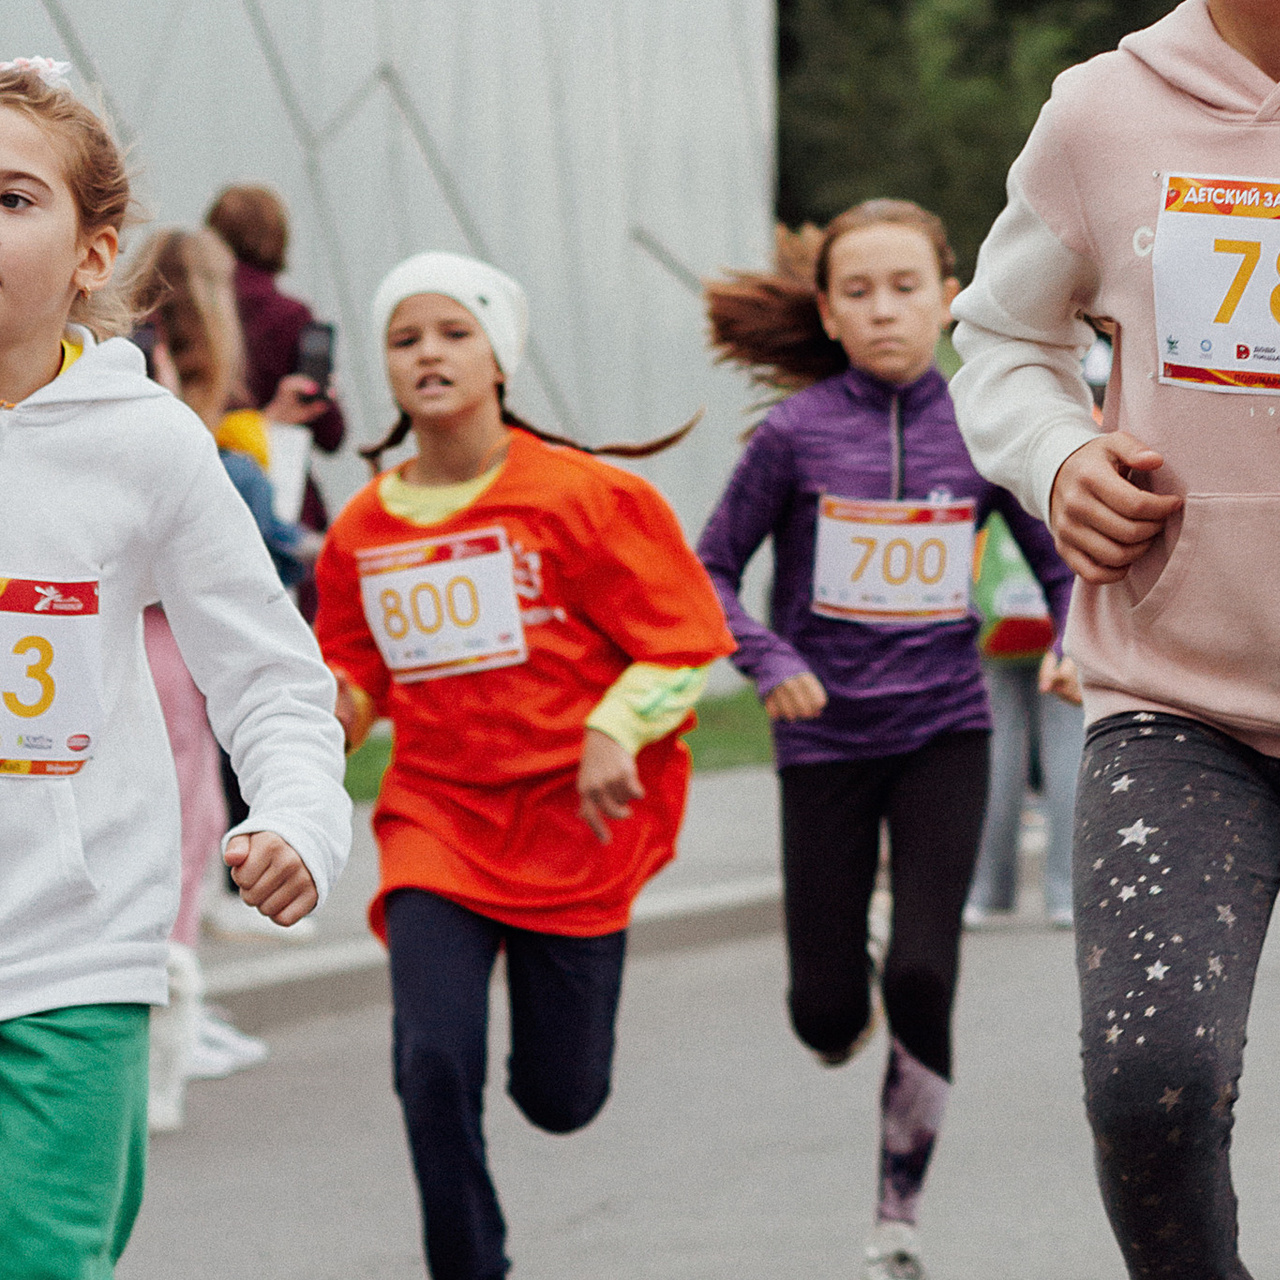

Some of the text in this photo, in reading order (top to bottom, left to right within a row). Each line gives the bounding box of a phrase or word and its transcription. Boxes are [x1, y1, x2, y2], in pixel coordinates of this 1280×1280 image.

[1183, 186, 1261, 206] ДЕТСКИЙ
[851, 537, 947, 585] 700
[380, 576, 480, 640] 800
